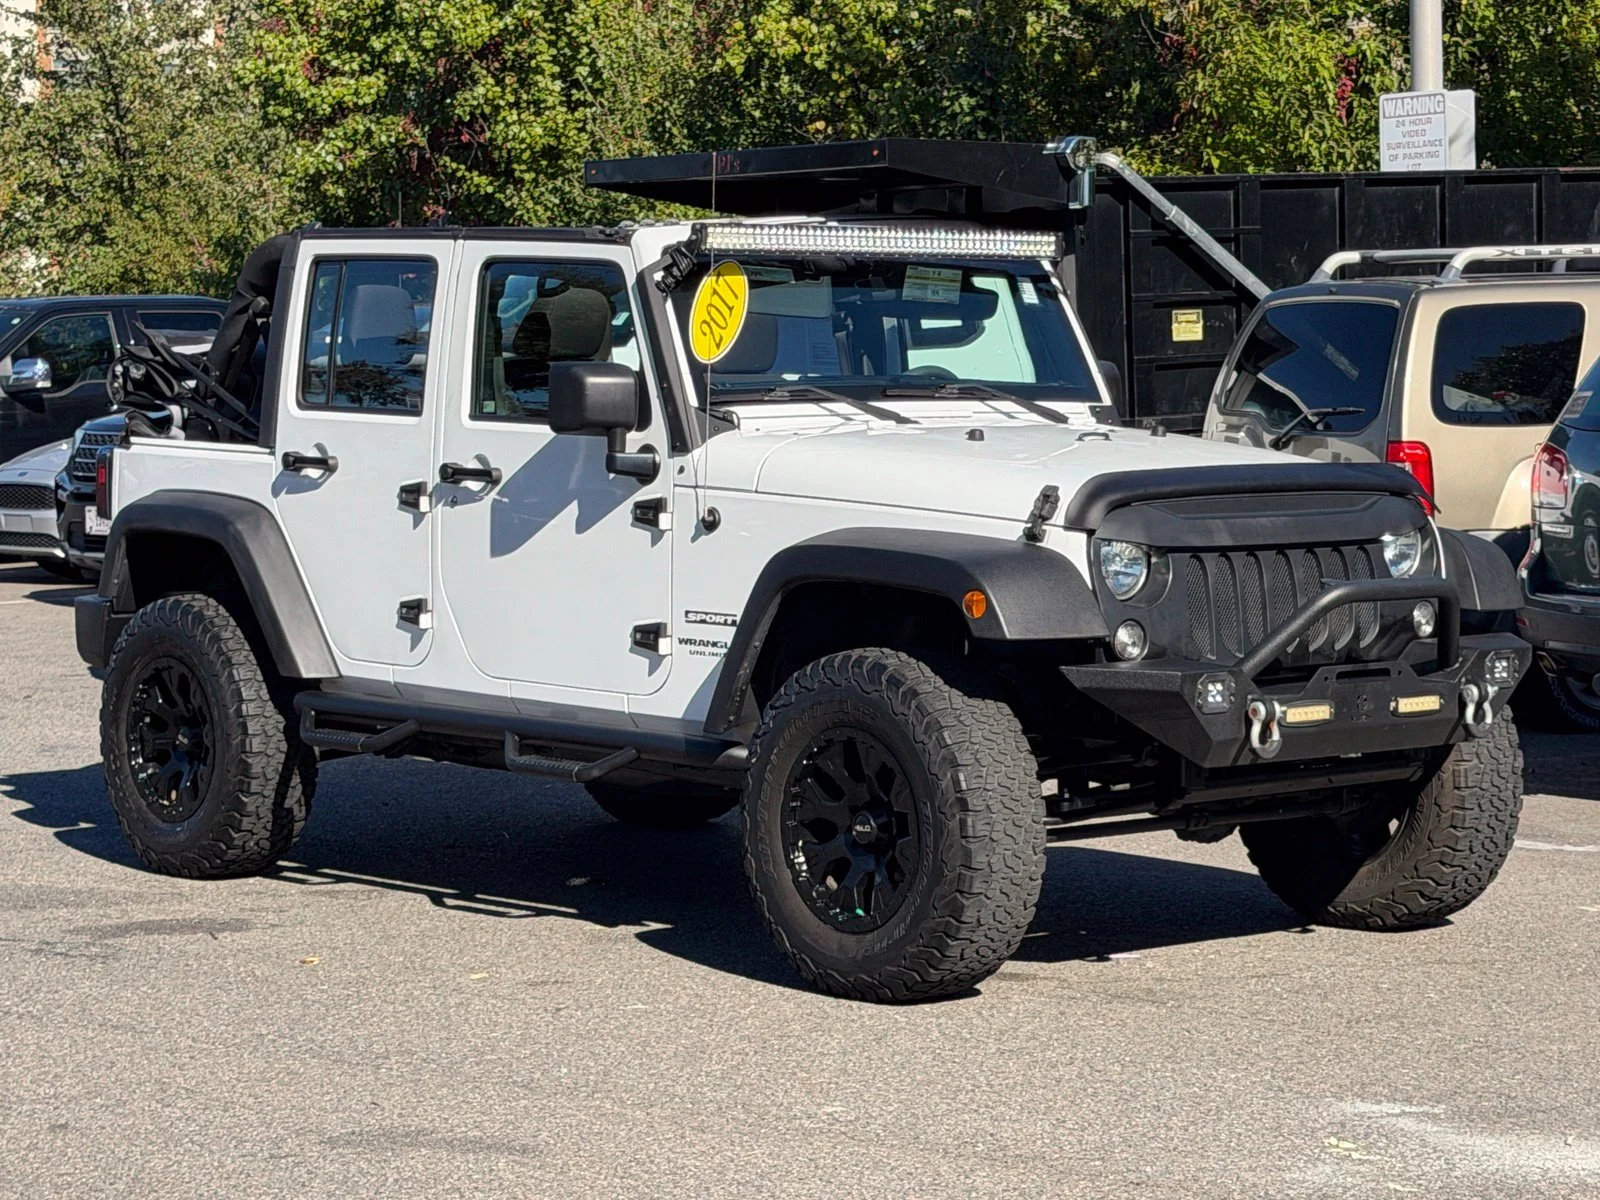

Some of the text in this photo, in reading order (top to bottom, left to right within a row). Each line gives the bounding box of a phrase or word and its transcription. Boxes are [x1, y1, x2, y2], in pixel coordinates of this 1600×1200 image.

[1383, 95, 1444, 117] WARNING
[1395, 117, 1432, 128] 24 HOUR
[1401, 129, 1427, 138] VIDEO
[1386, 139, 1443, 151] SURVEILLANCE
[1388, 150, 1440, 162] OF PARKING
[700, 271, 739, 350] 2017
[686, 612, 738, 625] SPORT
[677, 637, 730, 650] WRANGL
[689, 649, 726, 658] UNLIMI
